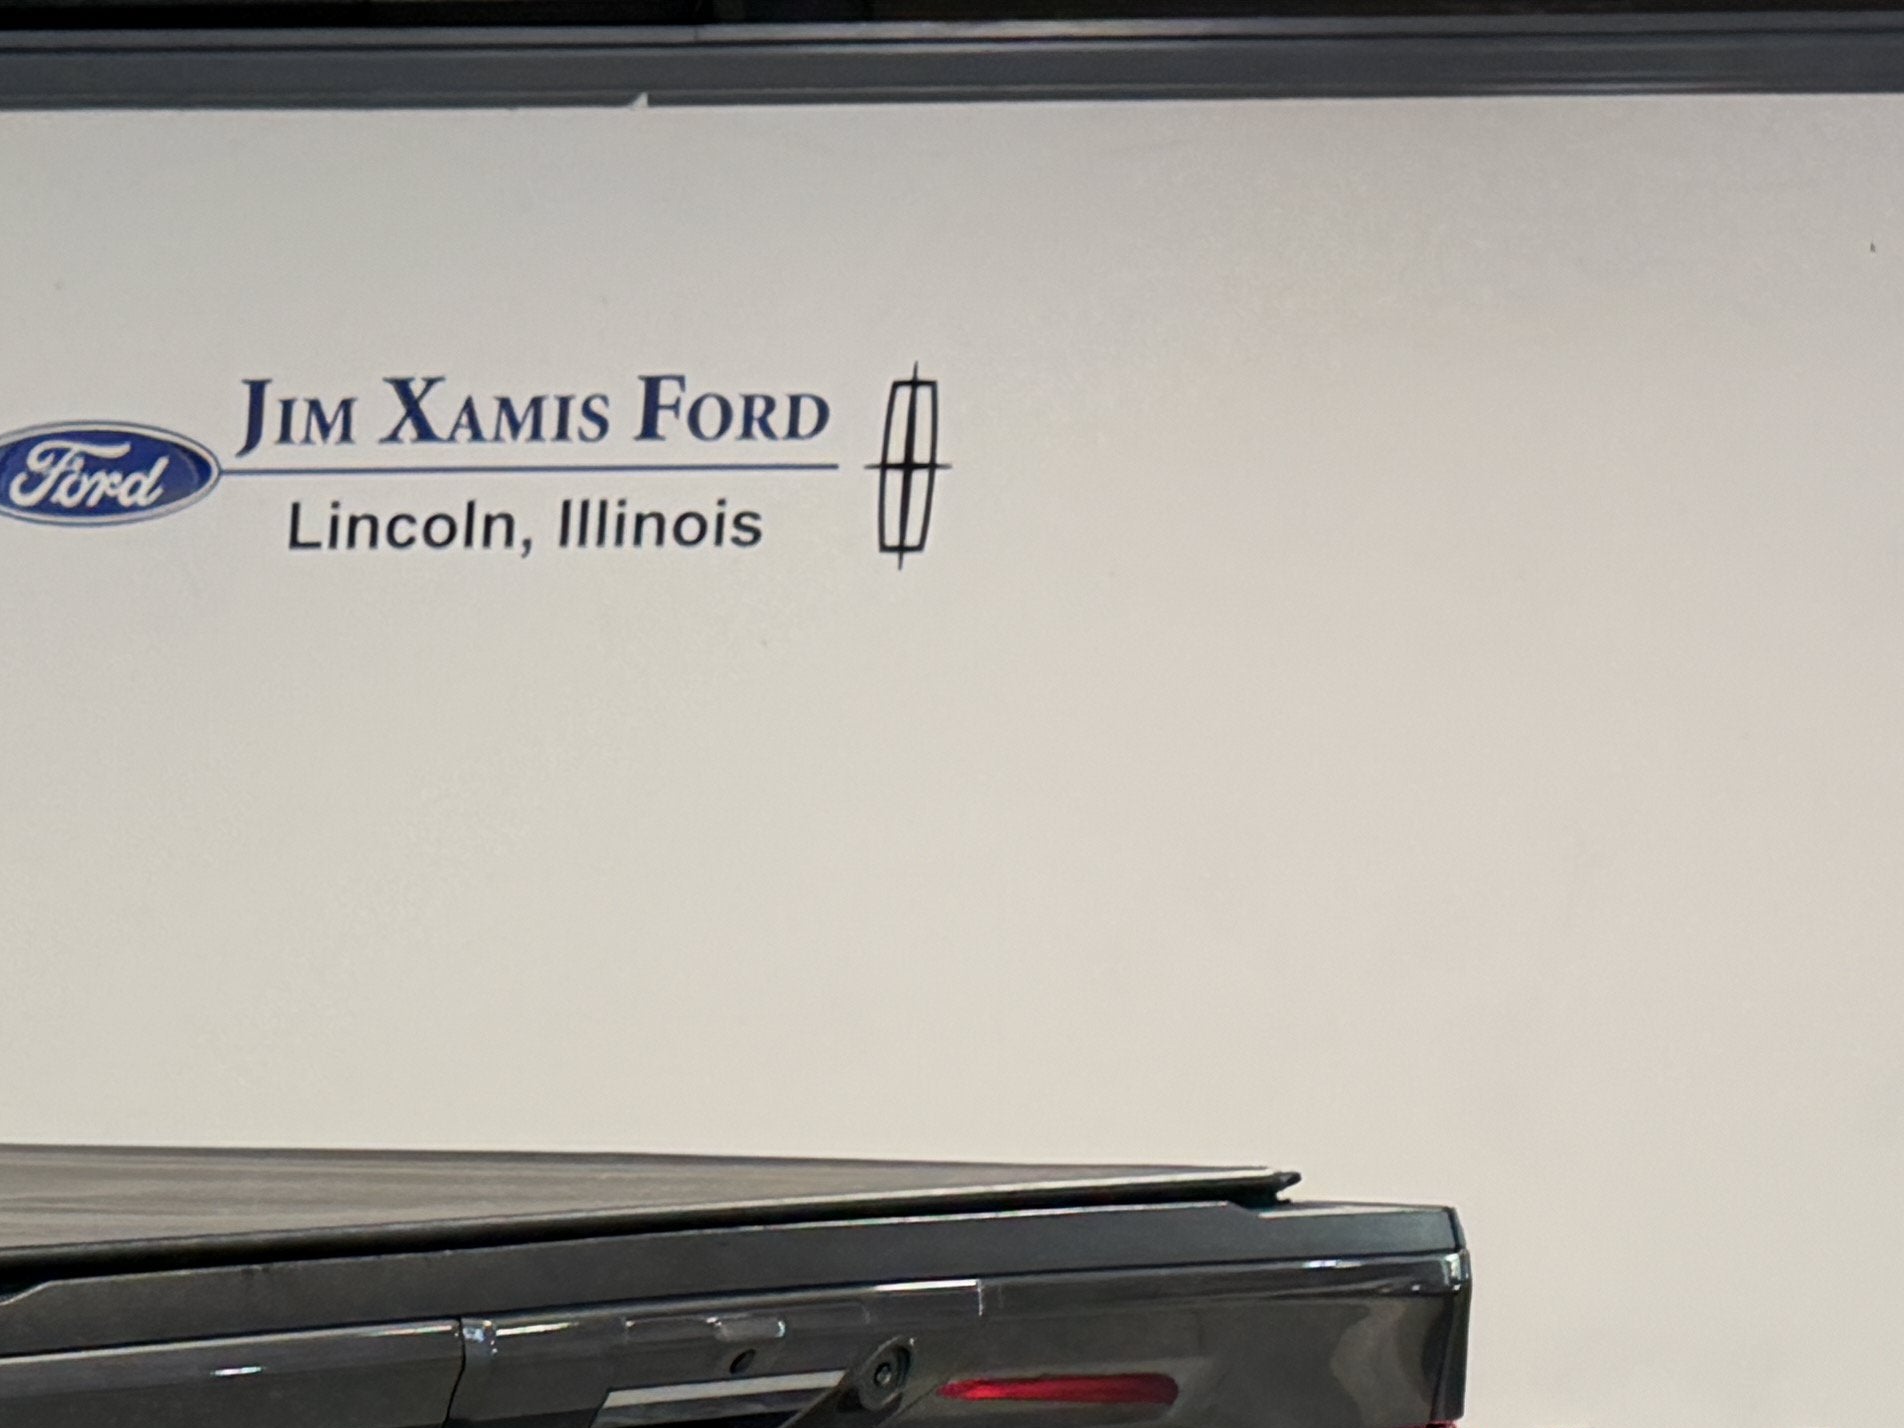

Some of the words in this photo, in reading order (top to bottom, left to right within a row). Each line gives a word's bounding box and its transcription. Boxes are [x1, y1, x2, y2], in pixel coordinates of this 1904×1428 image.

[236, 376, 357, 458] JIM
[379, 374, 611, 446] XAMIS
[635, 373, 831, 444] FORD
[8, 438, 169, 509] Ford
[288, 497, 533, 559] Lincoln,
[558, 498, 763, 549] Illinois
